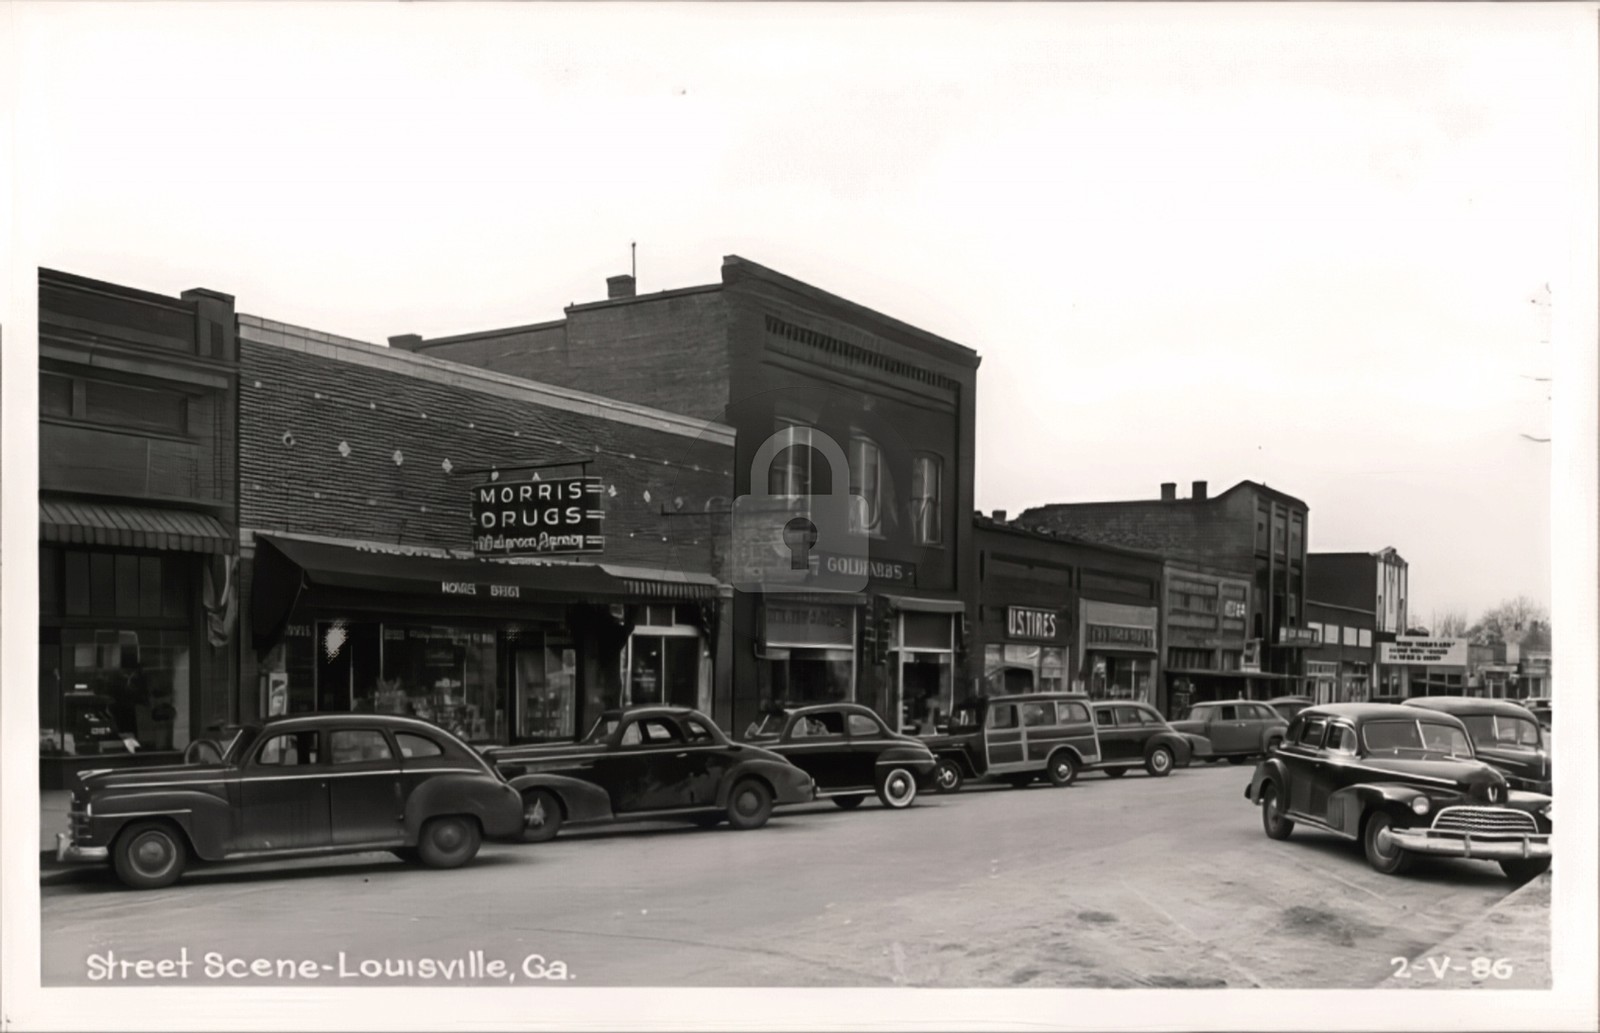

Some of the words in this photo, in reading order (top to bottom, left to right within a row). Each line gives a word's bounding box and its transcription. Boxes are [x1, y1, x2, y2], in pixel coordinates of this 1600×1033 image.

[481, 482, 582, 504] MORRIS
[481, 507, 582, 528] DRUGS
[1025, 610, 1057, 638] TIRES
